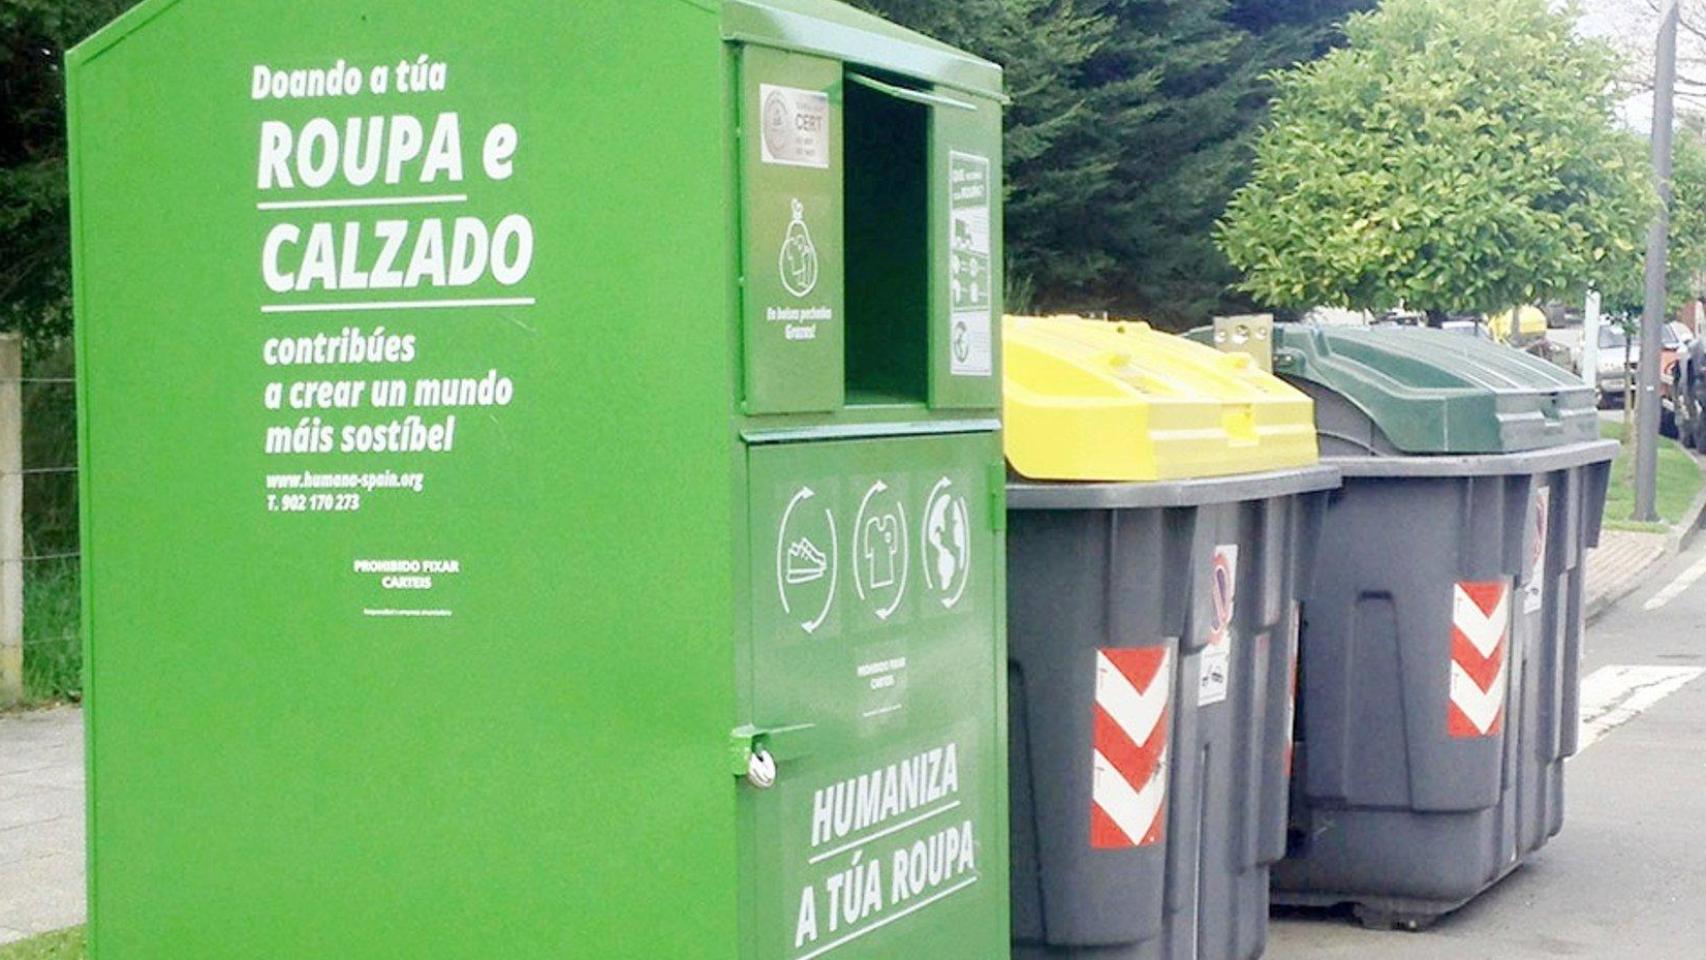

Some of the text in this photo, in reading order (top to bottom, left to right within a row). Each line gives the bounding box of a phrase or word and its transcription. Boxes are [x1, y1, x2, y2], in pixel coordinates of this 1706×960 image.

[251, 54, 447, 100] Doando a túa
[257, 112, 518, 189] ROUPA e
[262, 213, 534, 293] CALZADO
[263, 327, 416, 365] contribúes
[264, 368, 514, 409] a crear un mundo
[265, 415, 456, 454] máis sostíbel
[266, 469, 424, 492] www.humana-spain.org
[267, 493, 361, 512] T. 902 170 273
[353, 559, 460, 573] PROHIBIDO FIXAR
[381, 575, 432, 589] CARTEIS
[811, 742, 959, 847] HUMANIZA
[795, 820, 975, 948] A TÚA ROUPA
